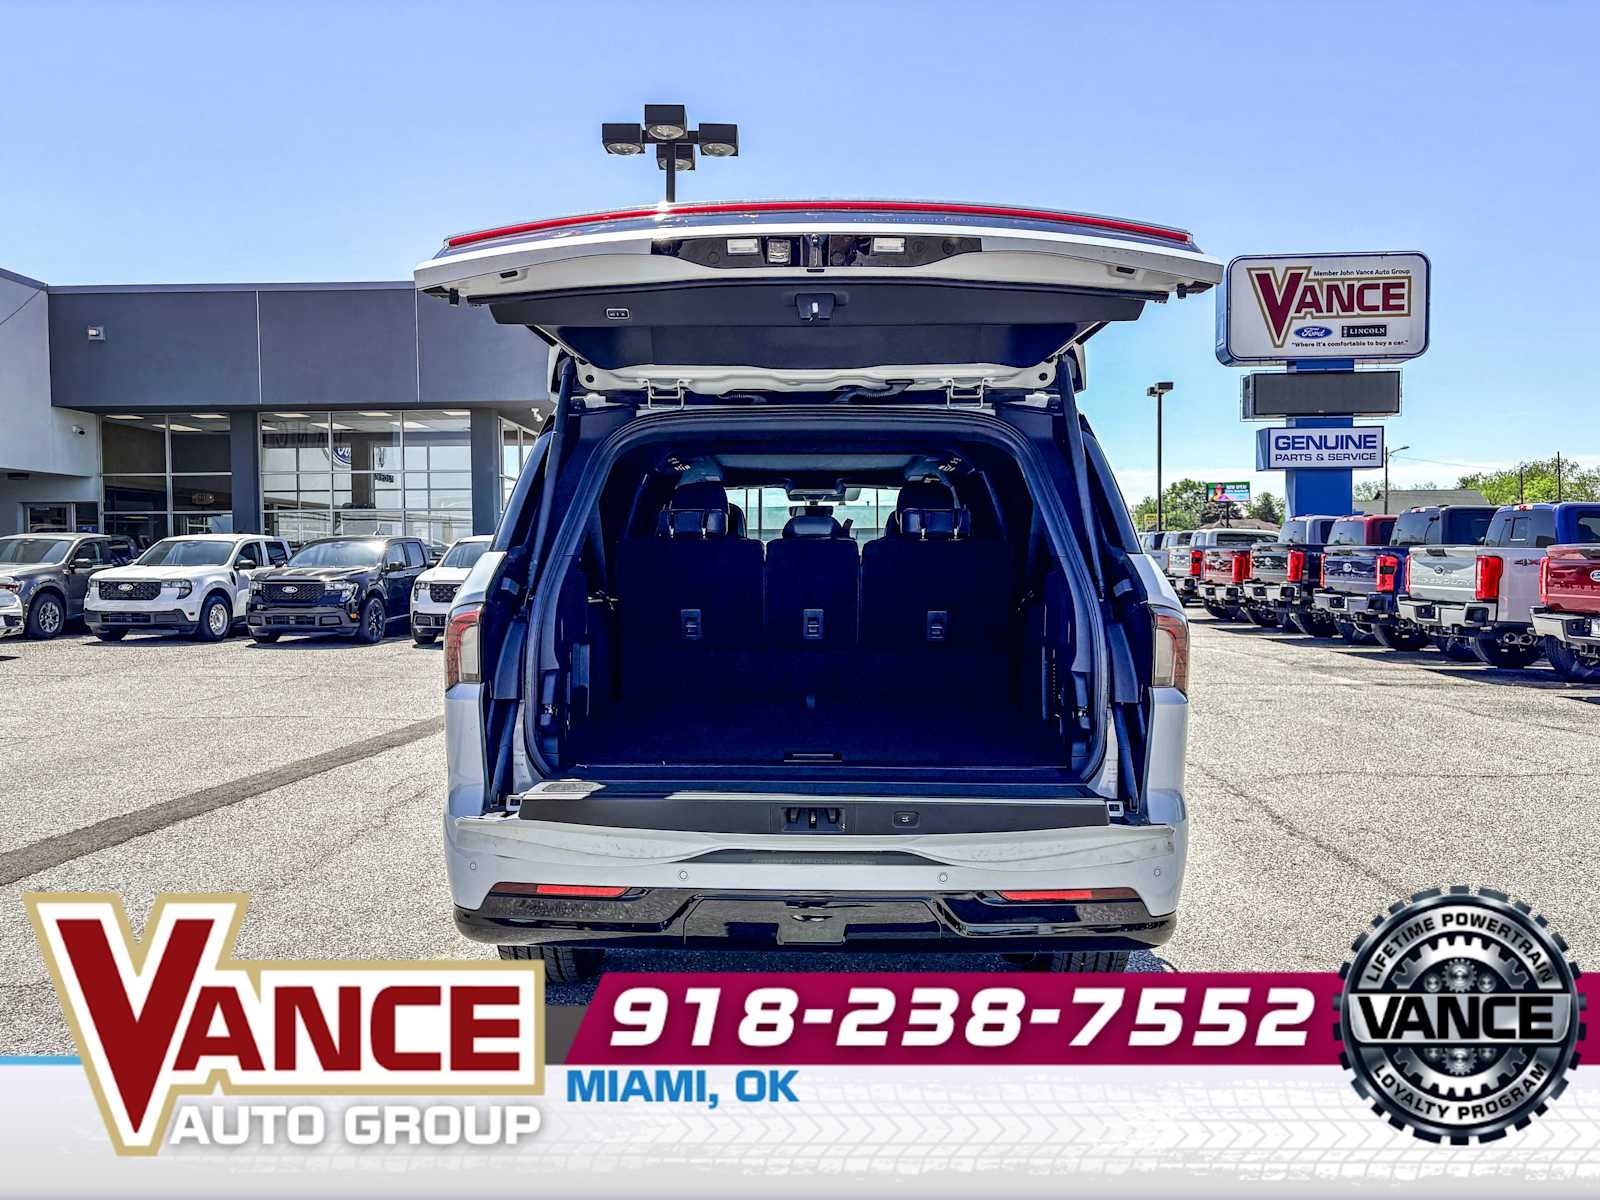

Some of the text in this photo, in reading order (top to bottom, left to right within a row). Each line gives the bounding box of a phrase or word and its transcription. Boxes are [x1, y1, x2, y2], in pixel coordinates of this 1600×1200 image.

[1255, 271, 1406, 343] VANCE
[1301, 327, 1326, 337] Ford
[1349, 327, 1386, 335] LINCOLN
[1375, 339, 1387, 347] buy
[1274, 434, 1377, 451] GENUINE
[1275, 452, 1377, 461] PARTS & SERVICE
